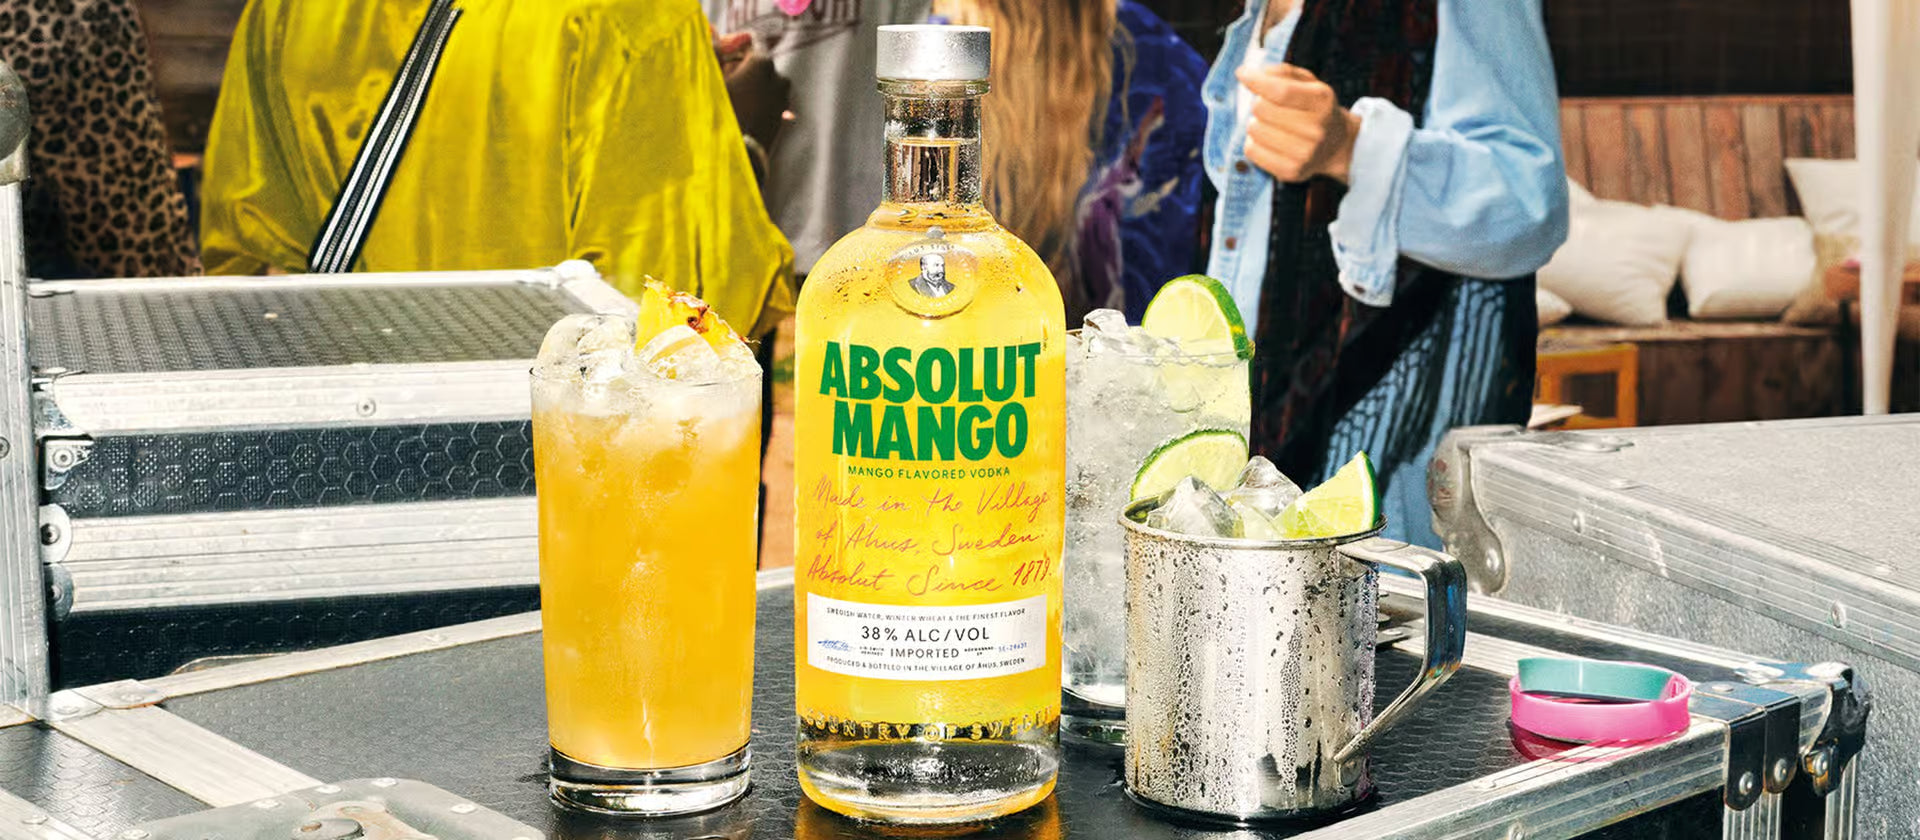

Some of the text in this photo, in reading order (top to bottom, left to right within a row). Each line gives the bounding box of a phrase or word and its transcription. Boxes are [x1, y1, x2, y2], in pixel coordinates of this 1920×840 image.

[819, 341, 1041, 404] ABSOLUT
[832, 400, 1028, 461] MANGO
[848, 465, 1010, 480] MANGO FLAVORED VODKA
[813, 475, 865, 509] Made
[877, 495, 910, 512] in
[922, 487, 963, 516] the
[815, 520, 838, 548] of
[807, 554, 896, 591] Absolut
[826, 607, 855, 617] SWEDISH
[886, 614, 917, 622] WINTER
[972, 612, 998, 620] FINEST
[1000, 608, 1025, 617] FLAVOR
[826, 655, 860, 667] PRODUCED
[868, 661, 901, 671] BOTTLED
[914, 664, 929, 672] THE
[931, 664, 963, 672] VILLAGE
[965, 663, 975, 671] OF
[999, 657, 1025, 667] SWEDEN
[890, 648, 960, 658] IMPORTED
